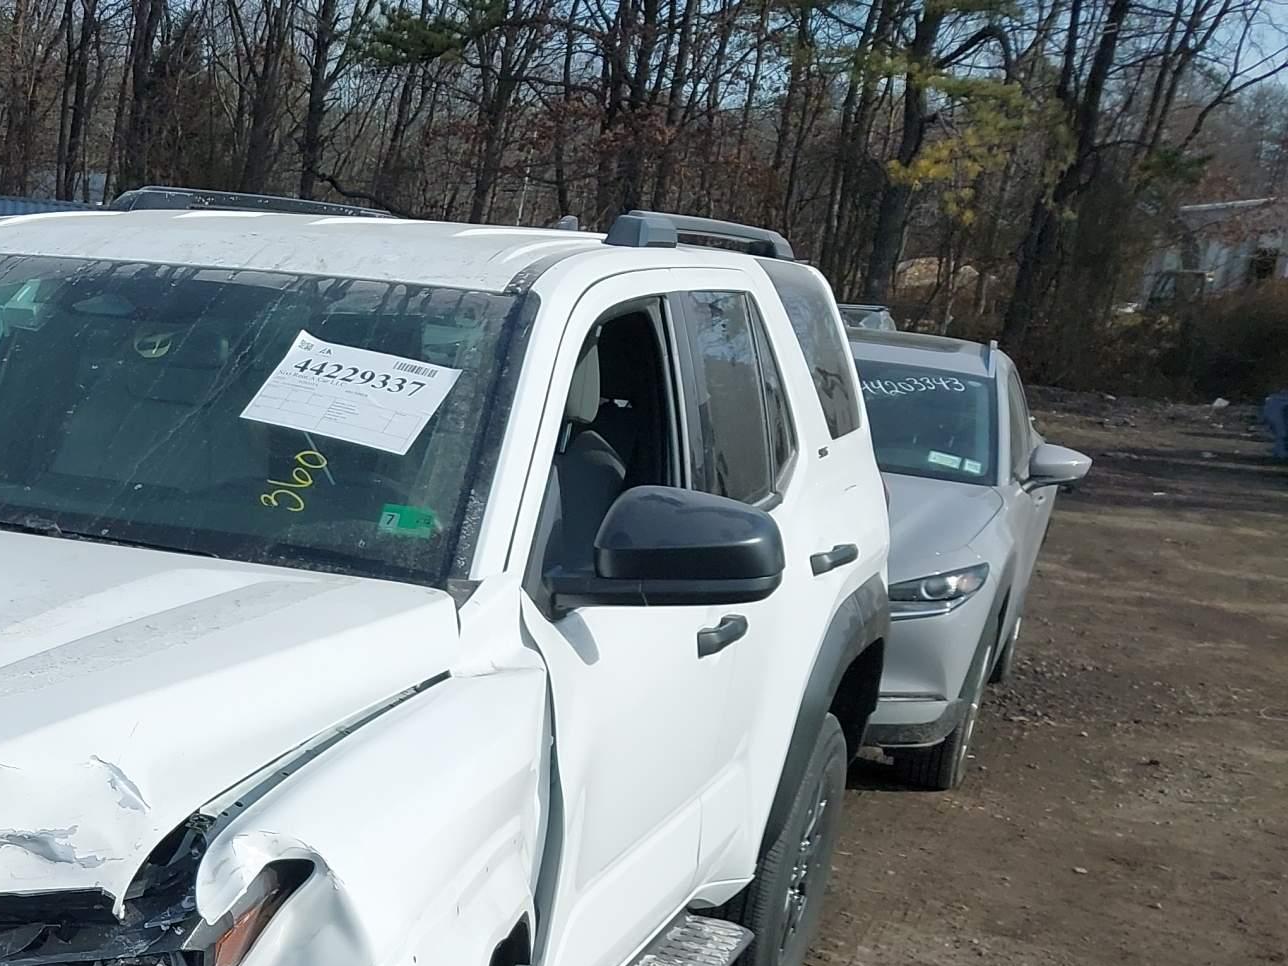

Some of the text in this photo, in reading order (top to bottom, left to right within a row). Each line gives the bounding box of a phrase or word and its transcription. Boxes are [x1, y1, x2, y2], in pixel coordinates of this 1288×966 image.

[293, 358, 426, 397] 44229337
[260, 450, 328, 512] 360
[386, 513, 396, 526] 7
